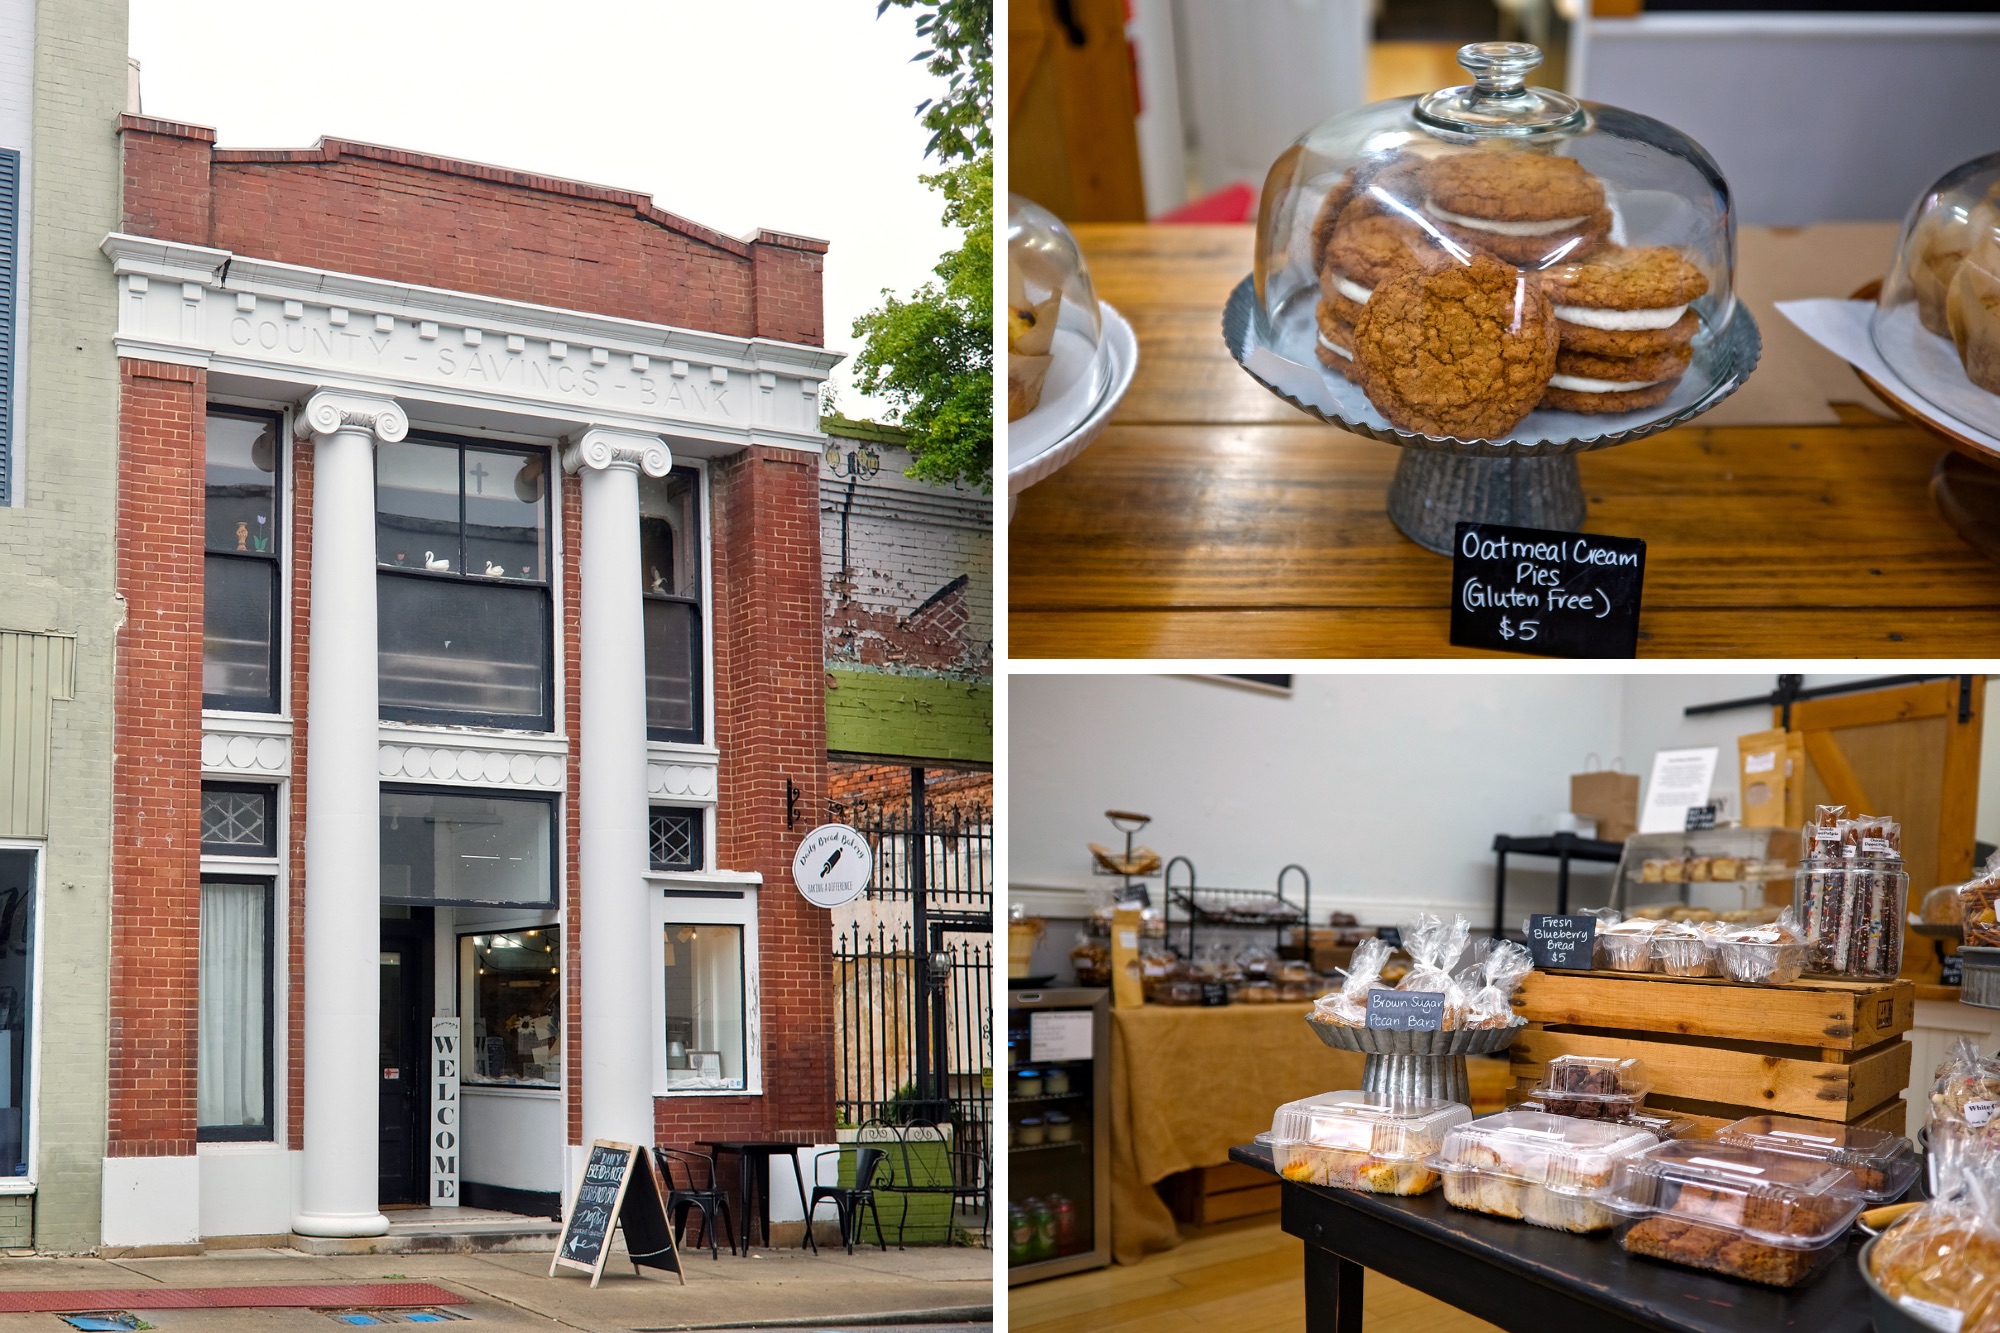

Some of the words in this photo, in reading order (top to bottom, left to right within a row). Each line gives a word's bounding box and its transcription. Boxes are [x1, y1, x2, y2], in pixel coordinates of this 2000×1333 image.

[230, 317, 391, 364] COUNTY
[640, 377, 732, 417] BANK
[1462, 532, 1567, 563] Oatmeal
[1573, 539, 1638, 567] Cream
[1516, 562, 1560, 586] Pies
[1462, 577, 1539, 613] (Gluten
[1547, 588, 1611, 618] Free)
[1498, 615, 1541, 641] $5
[800, 843, 817, 866] Daily
[818, 832, 839, 847] Bread
[841, 834, 865, 859] Bakery
[1542, 916, 1572, 928] Fresh
[1534, 928, 1588, 942] Blueberry
[1547, 940, 1575, 951] Bread
[1551, 951, 1567, 963] $5
[1372, 994, 1408, 1009] Brown
[1410, 996, 1444, 1014] Sugar
[1369, 1013, 1400, 1027] Pecan
[1408, 1015, 1437, 1028] Bars
[433, 1036, 459, 1198] WELCOME
[1968, 1104, 1991, 1112] White
